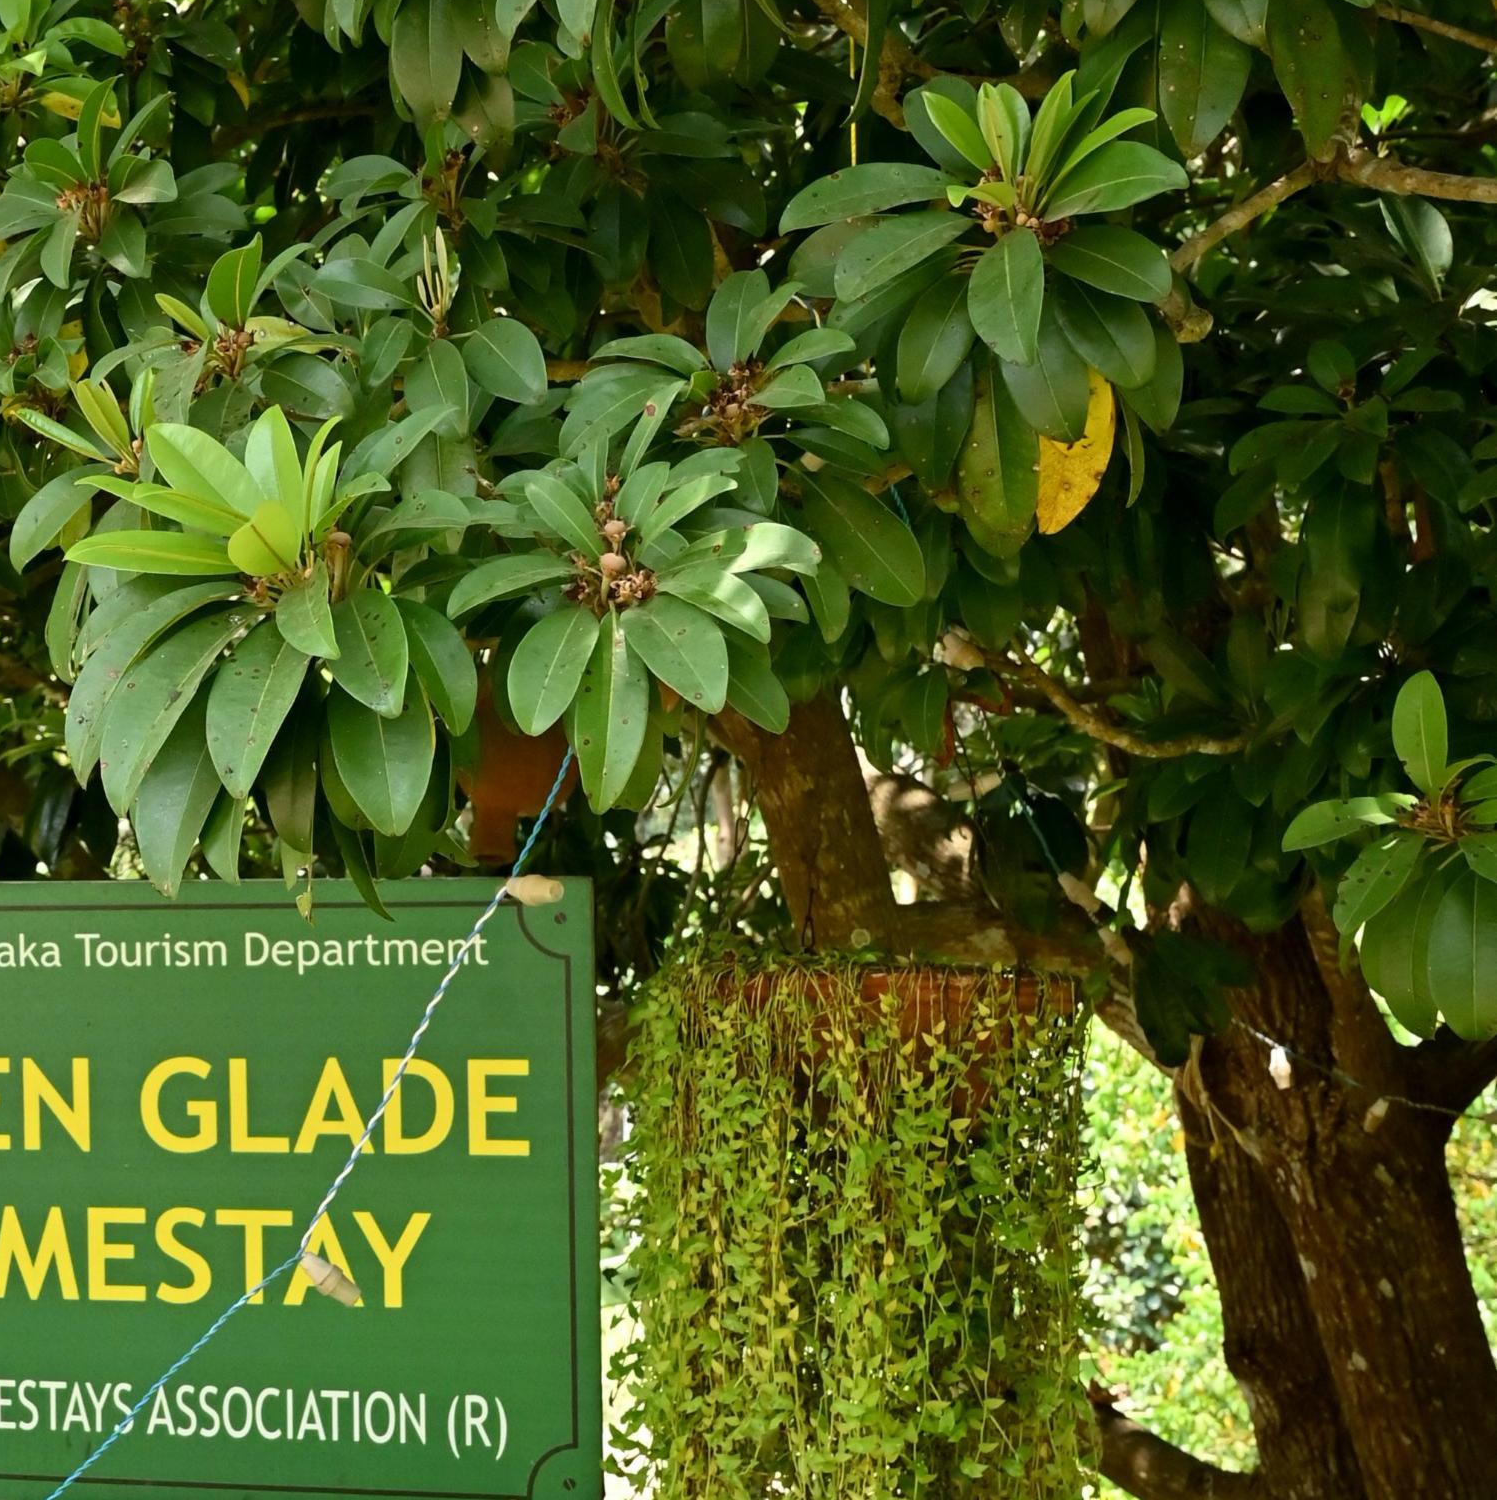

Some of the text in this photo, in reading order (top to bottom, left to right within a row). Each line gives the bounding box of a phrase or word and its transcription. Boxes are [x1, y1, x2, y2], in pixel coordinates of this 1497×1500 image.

[75, 933, 227, 967] Tourism
[245, 932, 489, 975] Department
[140, 1057, 530, 1156] GLADE
[146, 1385, 426, 1445] ASSOCIATION
[447, 1394, 507, 1460] (R)
